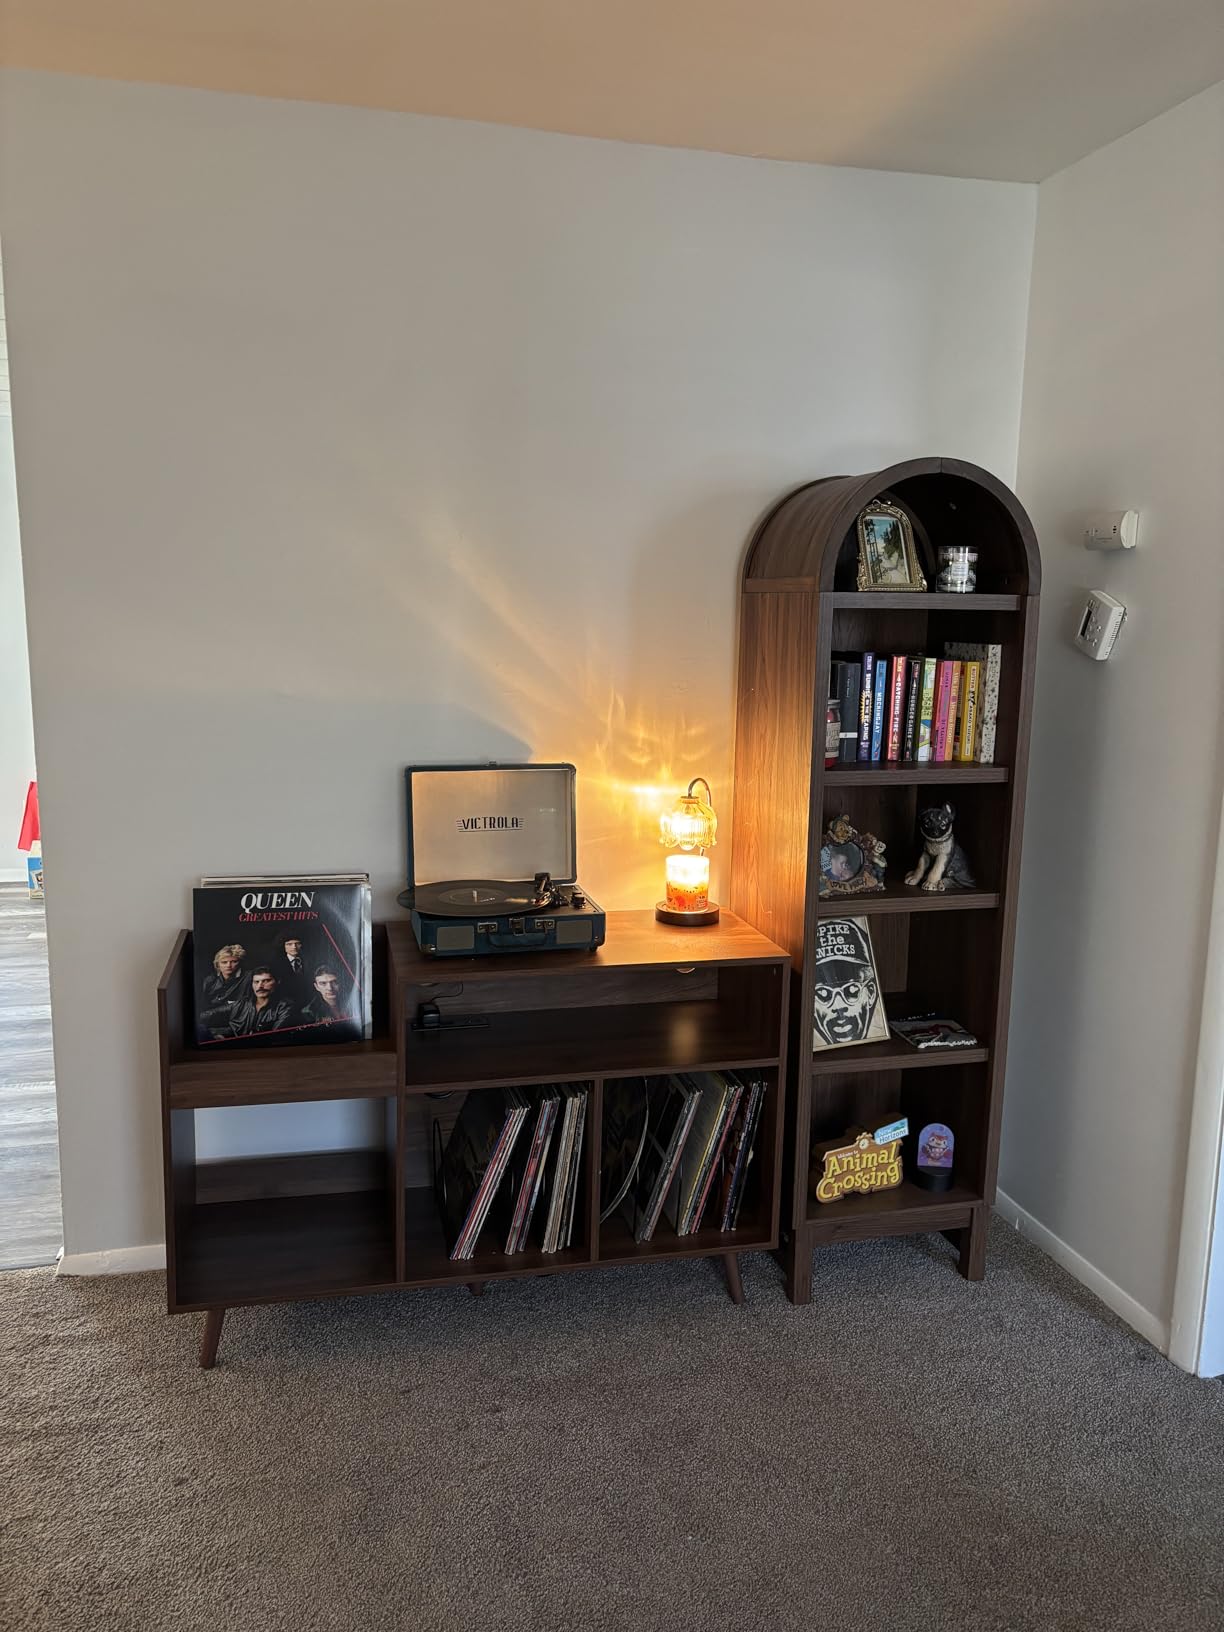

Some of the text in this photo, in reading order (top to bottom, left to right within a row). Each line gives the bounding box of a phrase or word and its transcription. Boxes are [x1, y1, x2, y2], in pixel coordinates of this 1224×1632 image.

[874, 692, 882, 734] MOCKINGJAY
[908, 695, 916, 719] HUNGER
[461, 816, 519, 830] VICTROLA
[240, 891, 315, 913] QUEEN
[239, 911, 319, 922] GREATEST HITS
[820, 934, 845, 946] the
[879, 1129, 907, 1143] Horizons
[827, 1142, 897, 1178] Animal
[819, 1161, 900, 1198] Crossing
